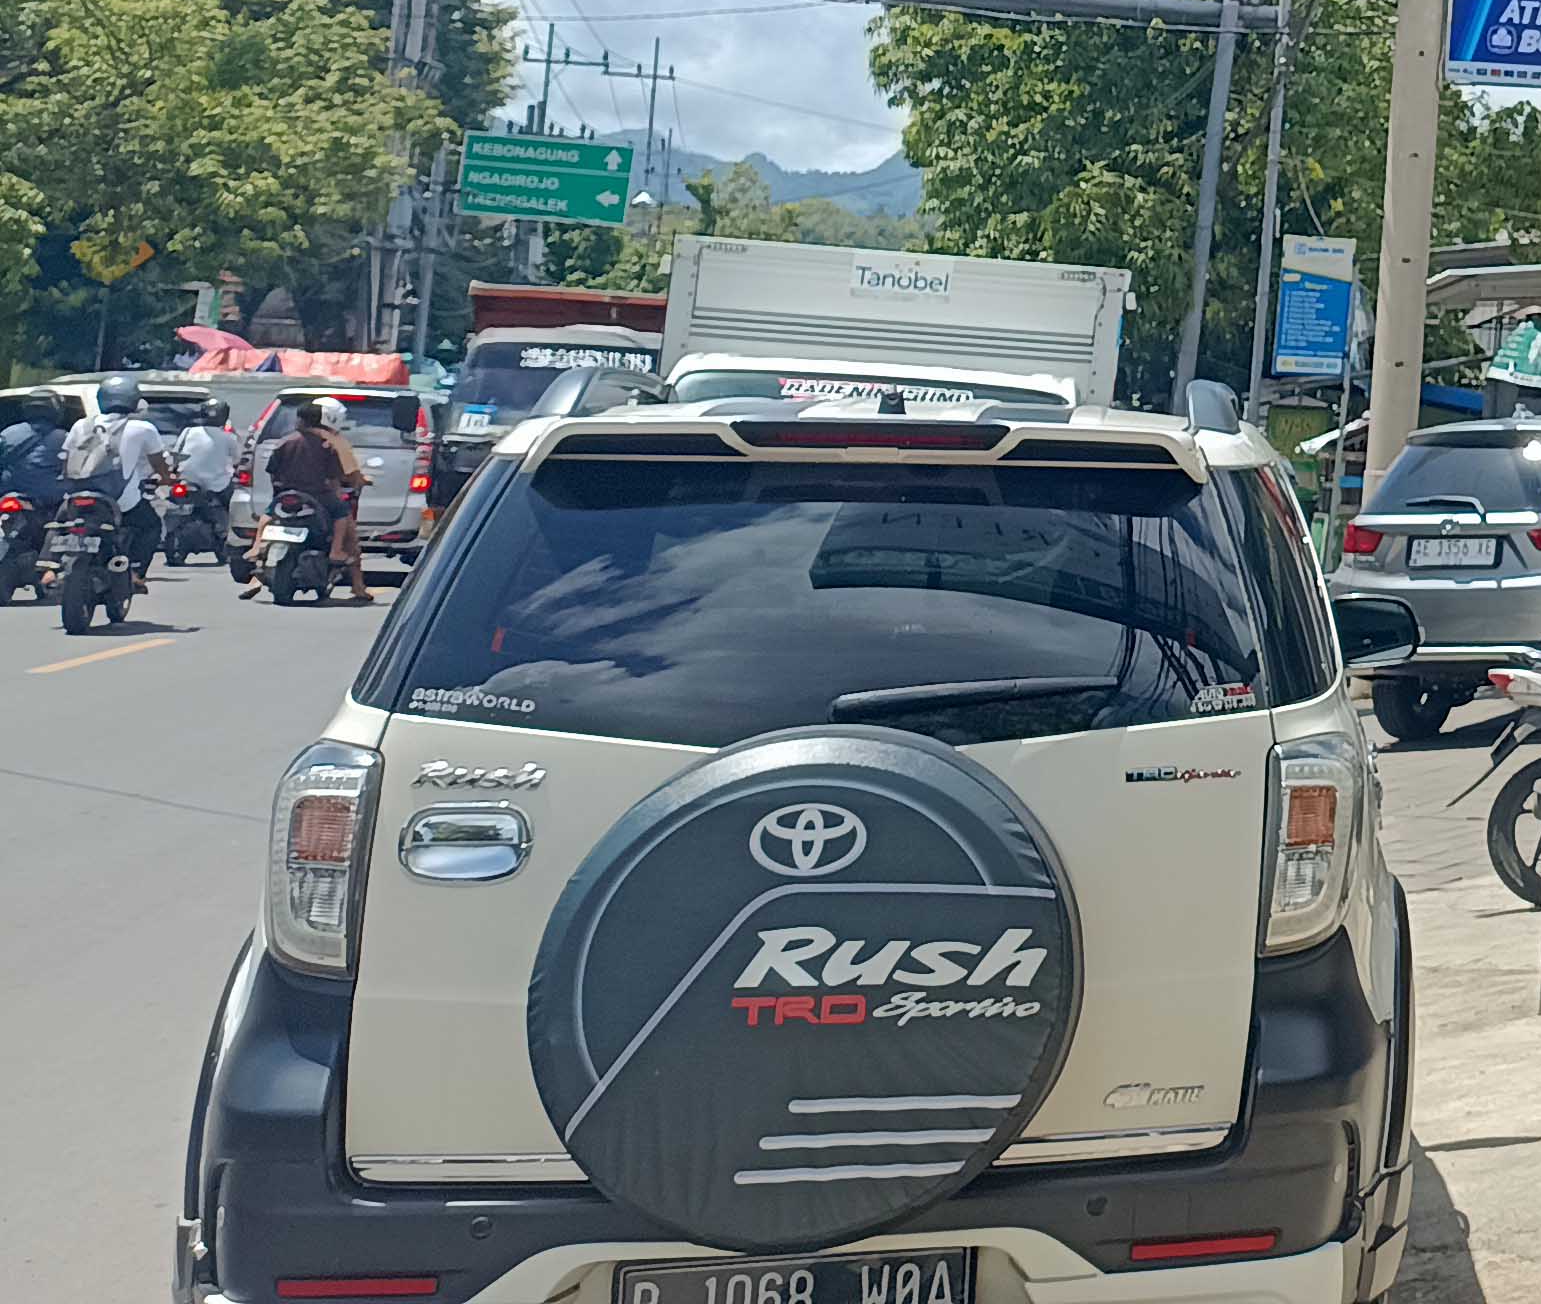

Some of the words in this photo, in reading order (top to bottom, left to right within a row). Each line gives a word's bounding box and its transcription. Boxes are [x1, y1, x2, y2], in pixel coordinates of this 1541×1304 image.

[473, 142, 580, 163] KEBONAGUNG
[468, 171, 559, 190] NGADIROJO
[856, 266, 948, 293] Tanobel
[411, 760, 546, 790] Rush
[734, 926, 1048, 989] Rush
[731, 995, 865, 1025] TRD
[872, 992, 1040, 1026] Sportivo
